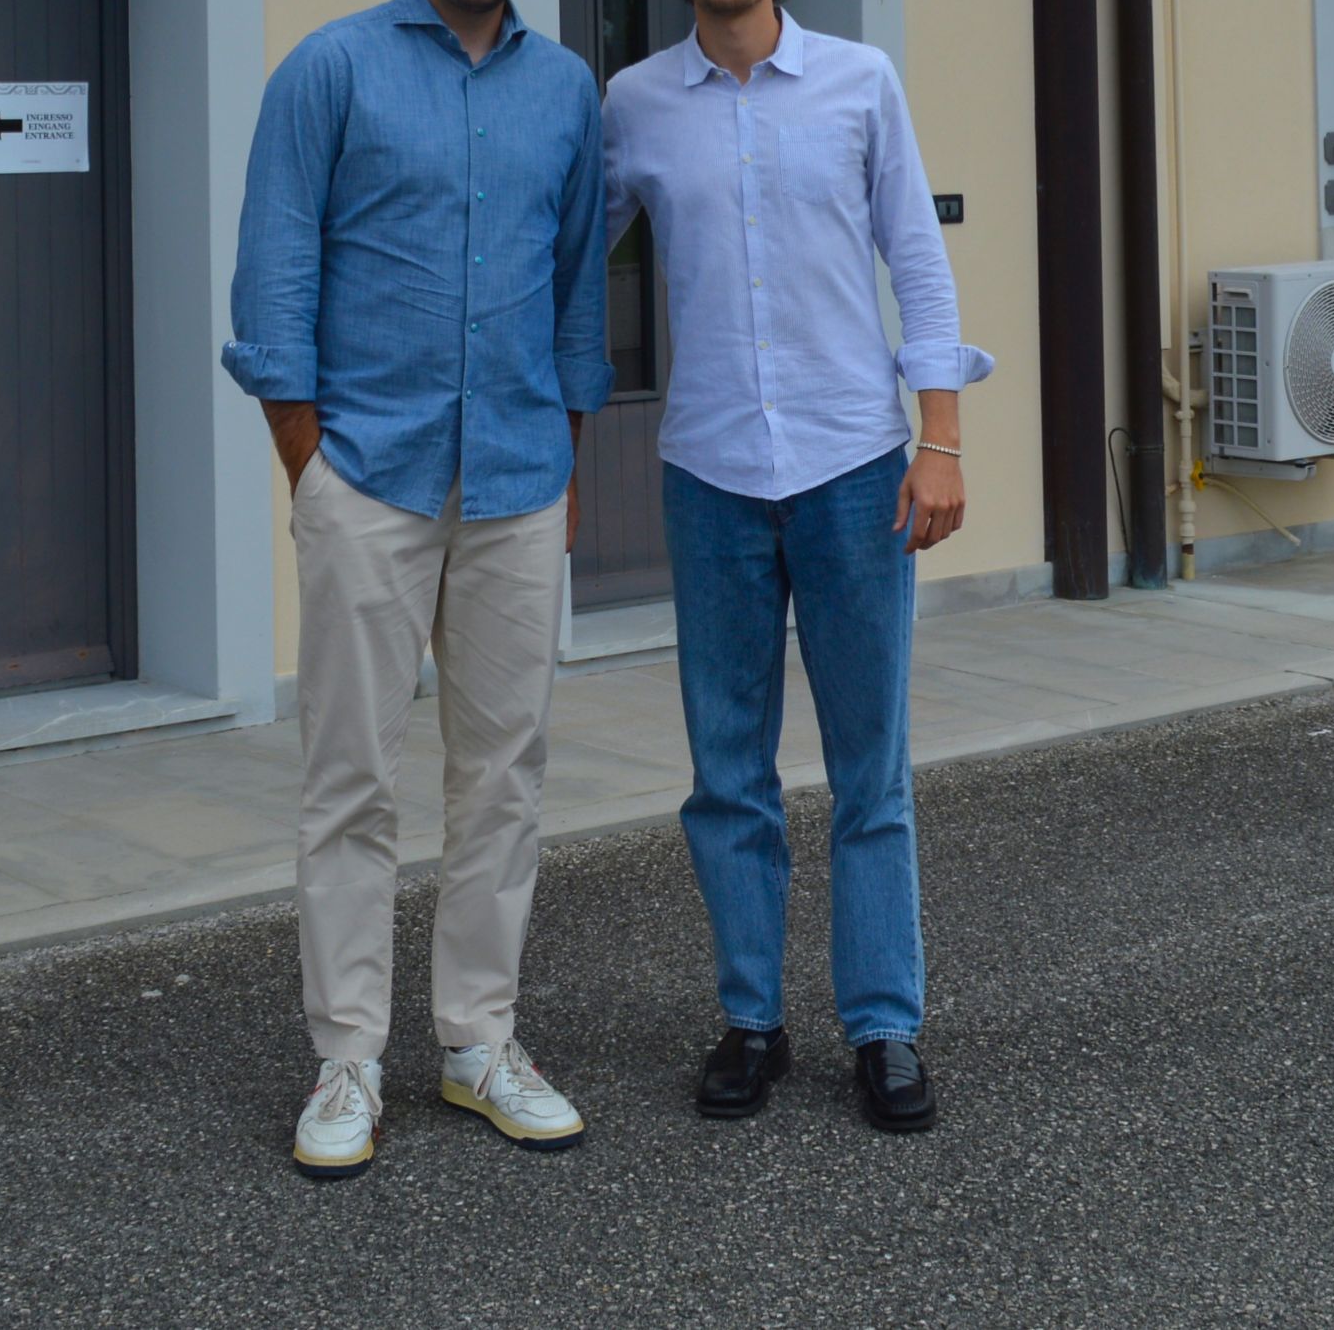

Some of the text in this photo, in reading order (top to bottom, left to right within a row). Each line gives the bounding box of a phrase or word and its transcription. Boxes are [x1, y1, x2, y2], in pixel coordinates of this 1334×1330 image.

[26, 113, 73, 122] INGRESSO
[28, 122, 71, 131] EINGANG
[24, 131, 75, 140] ENTRANCE
